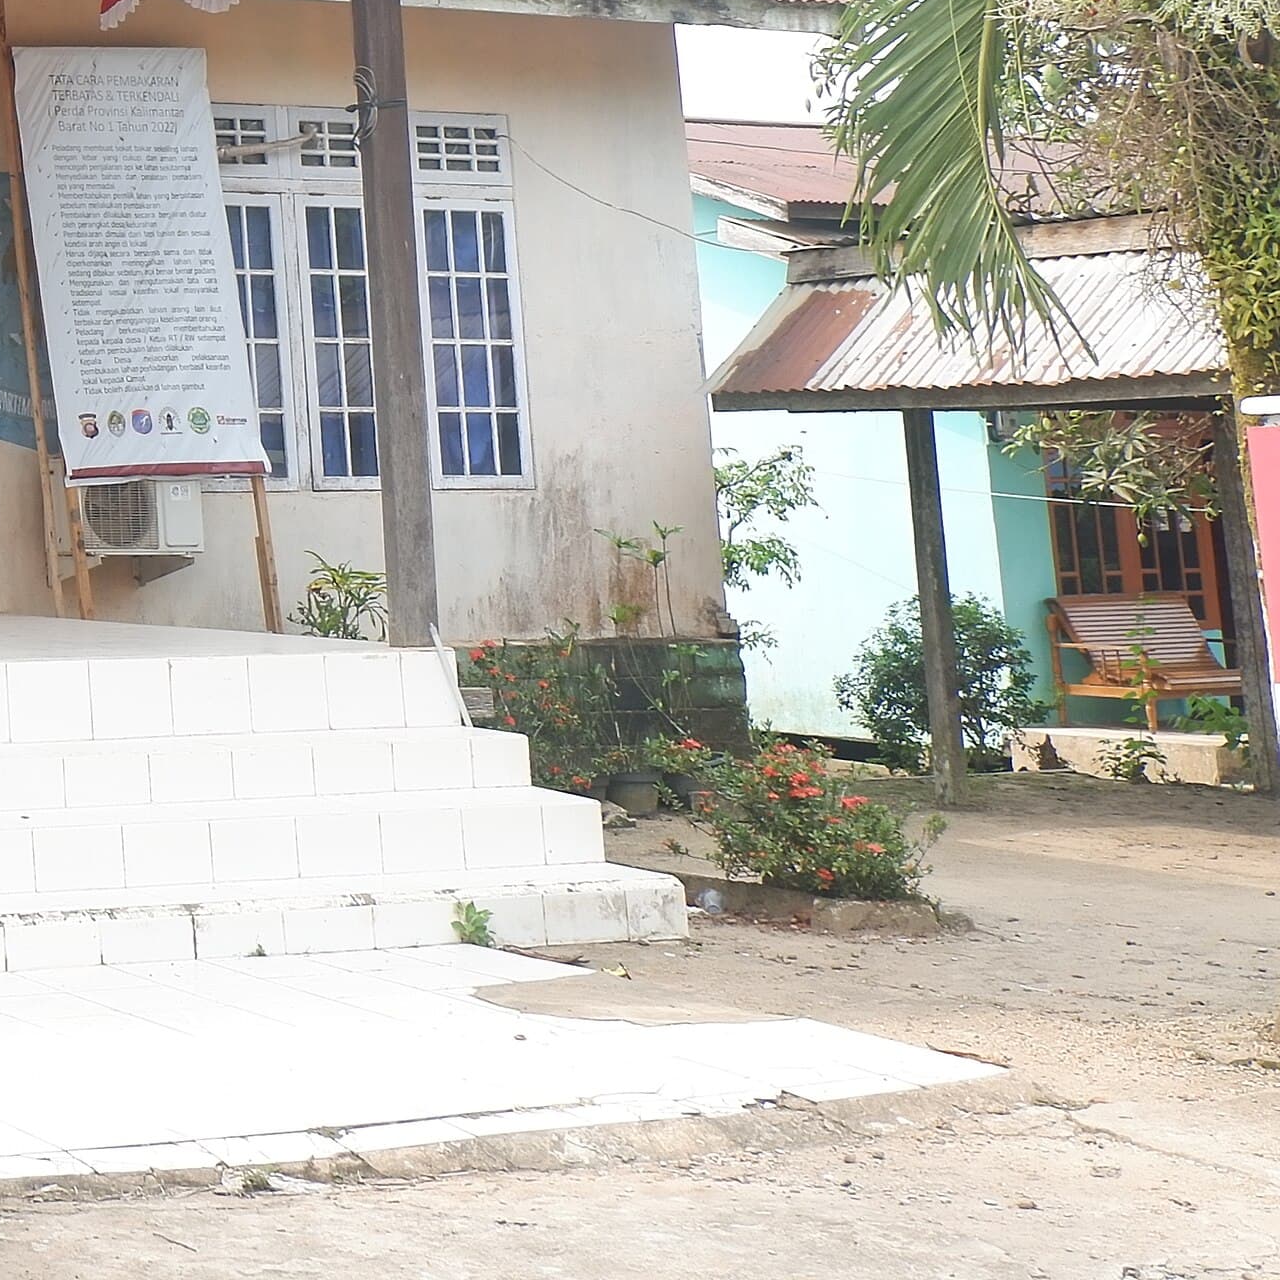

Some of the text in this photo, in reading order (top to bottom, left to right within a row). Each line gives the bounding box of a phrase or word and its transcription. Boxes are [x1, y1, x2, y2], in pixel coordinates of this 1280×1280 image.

[48, 74, 179, 87] TATA CARA PEMBAKARAN
[52, 89, 179, 102] TERBATAS & TERKENDALI
[54, 106, 85, 117] Perda
[88, 106, 128, 117] Provinsi
[130, 107, 185, 118] Kalimantan
[58, 121, 87, 132] Barat
[90, 122, 105, 131] No
[108, 122, 114, 131] 1
[117, 121, 148, 132] Tahun
